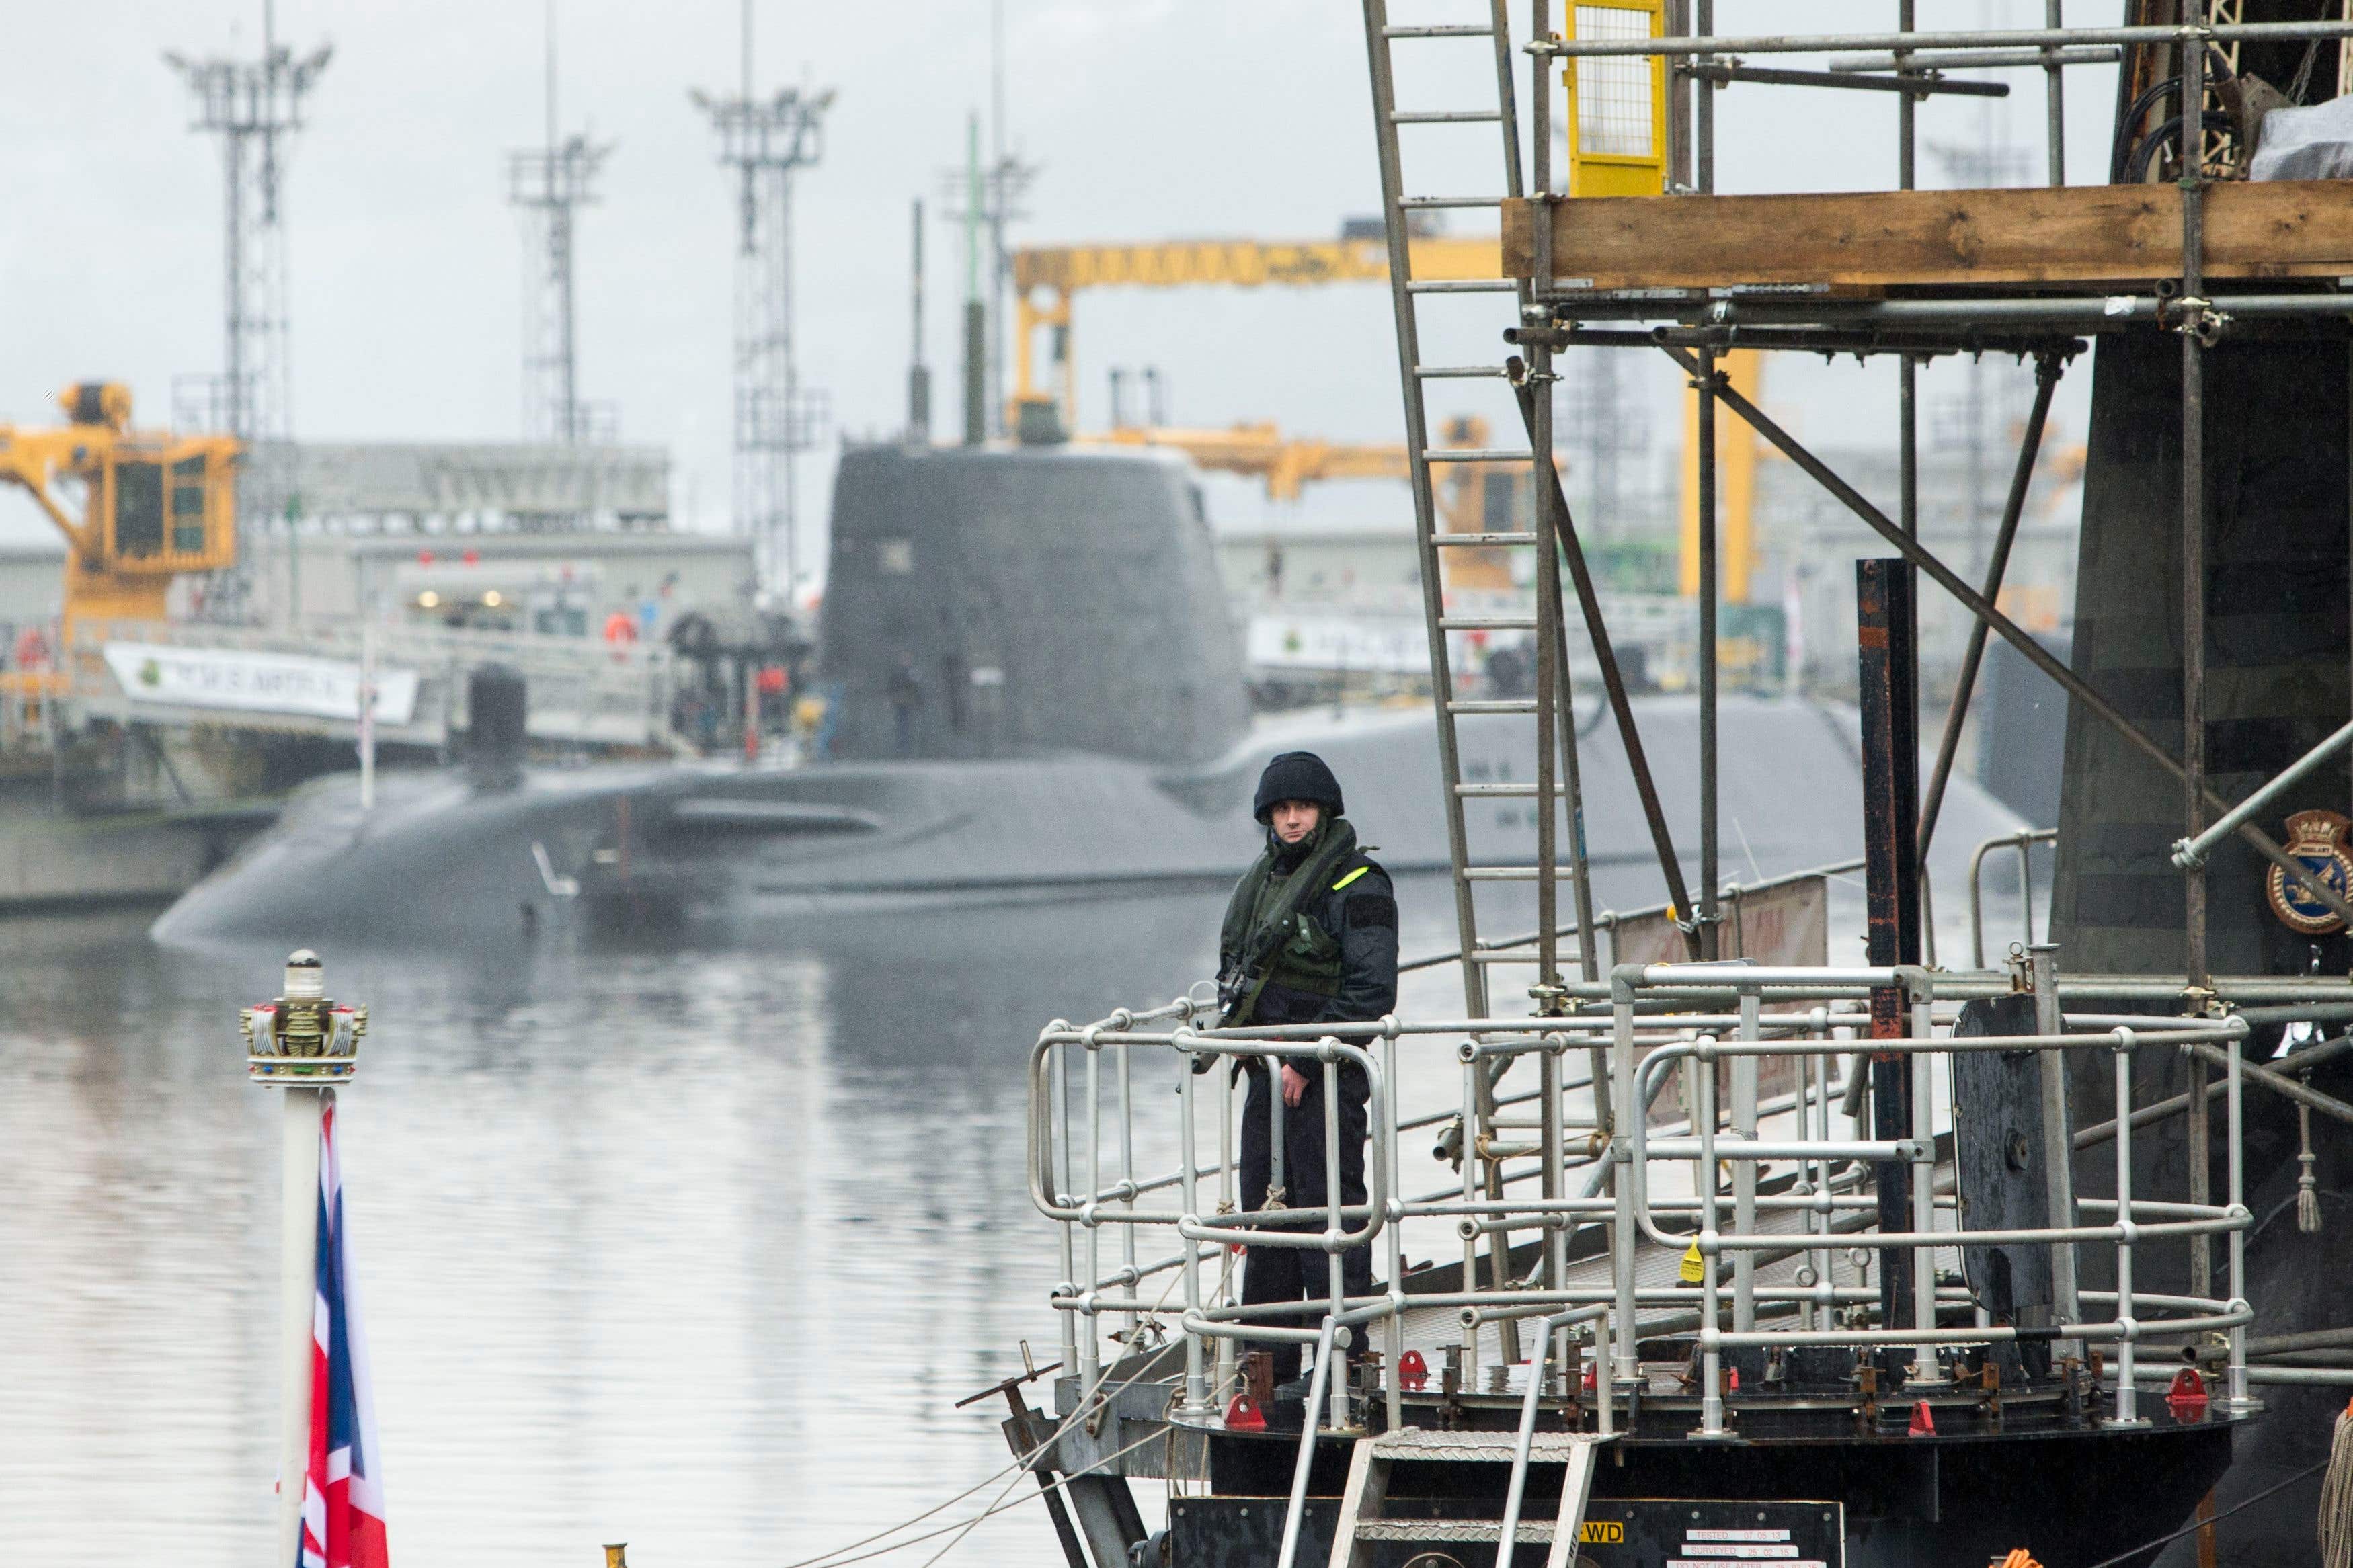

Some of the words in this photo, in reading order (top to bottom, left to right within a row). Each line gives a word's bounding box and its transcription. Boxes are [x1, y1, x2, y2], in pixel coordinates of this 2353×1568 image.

[1581, 1524, 1622, 1542] WD
[1691, 1546, 1737, 1555] SURVEYED
[1748, 1548, 1757, 1557] 25
[1763, 1548, 1773, 1557] 02
[1780, 1548, 1789, 1556] 15
